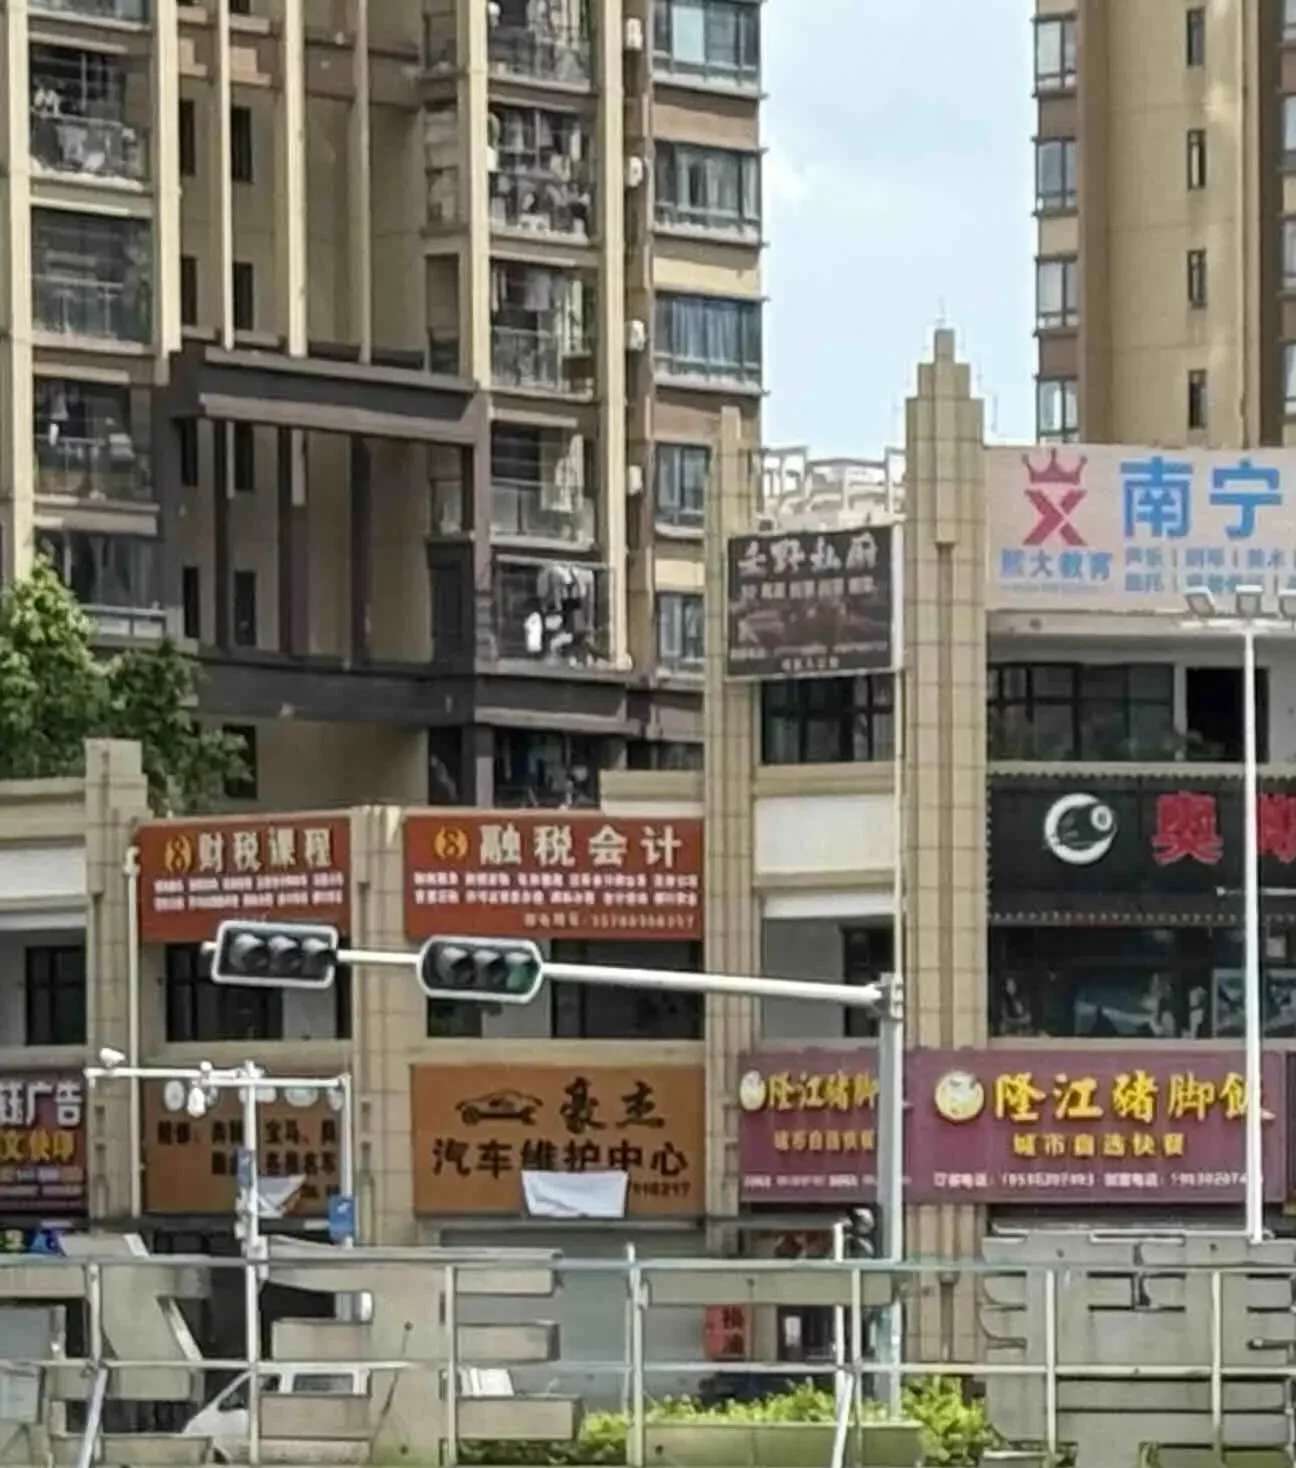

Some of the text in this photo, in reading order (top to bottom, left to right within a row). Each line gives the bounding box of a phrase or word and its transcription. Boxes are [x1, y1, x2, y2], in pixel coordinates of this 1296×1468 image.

[479, 822, 682, 867] 融税会计
[432, 1138, 688, 1179] 汽车维护中心
[1013, 1132, 1185, 1157] 城市自选快餐
